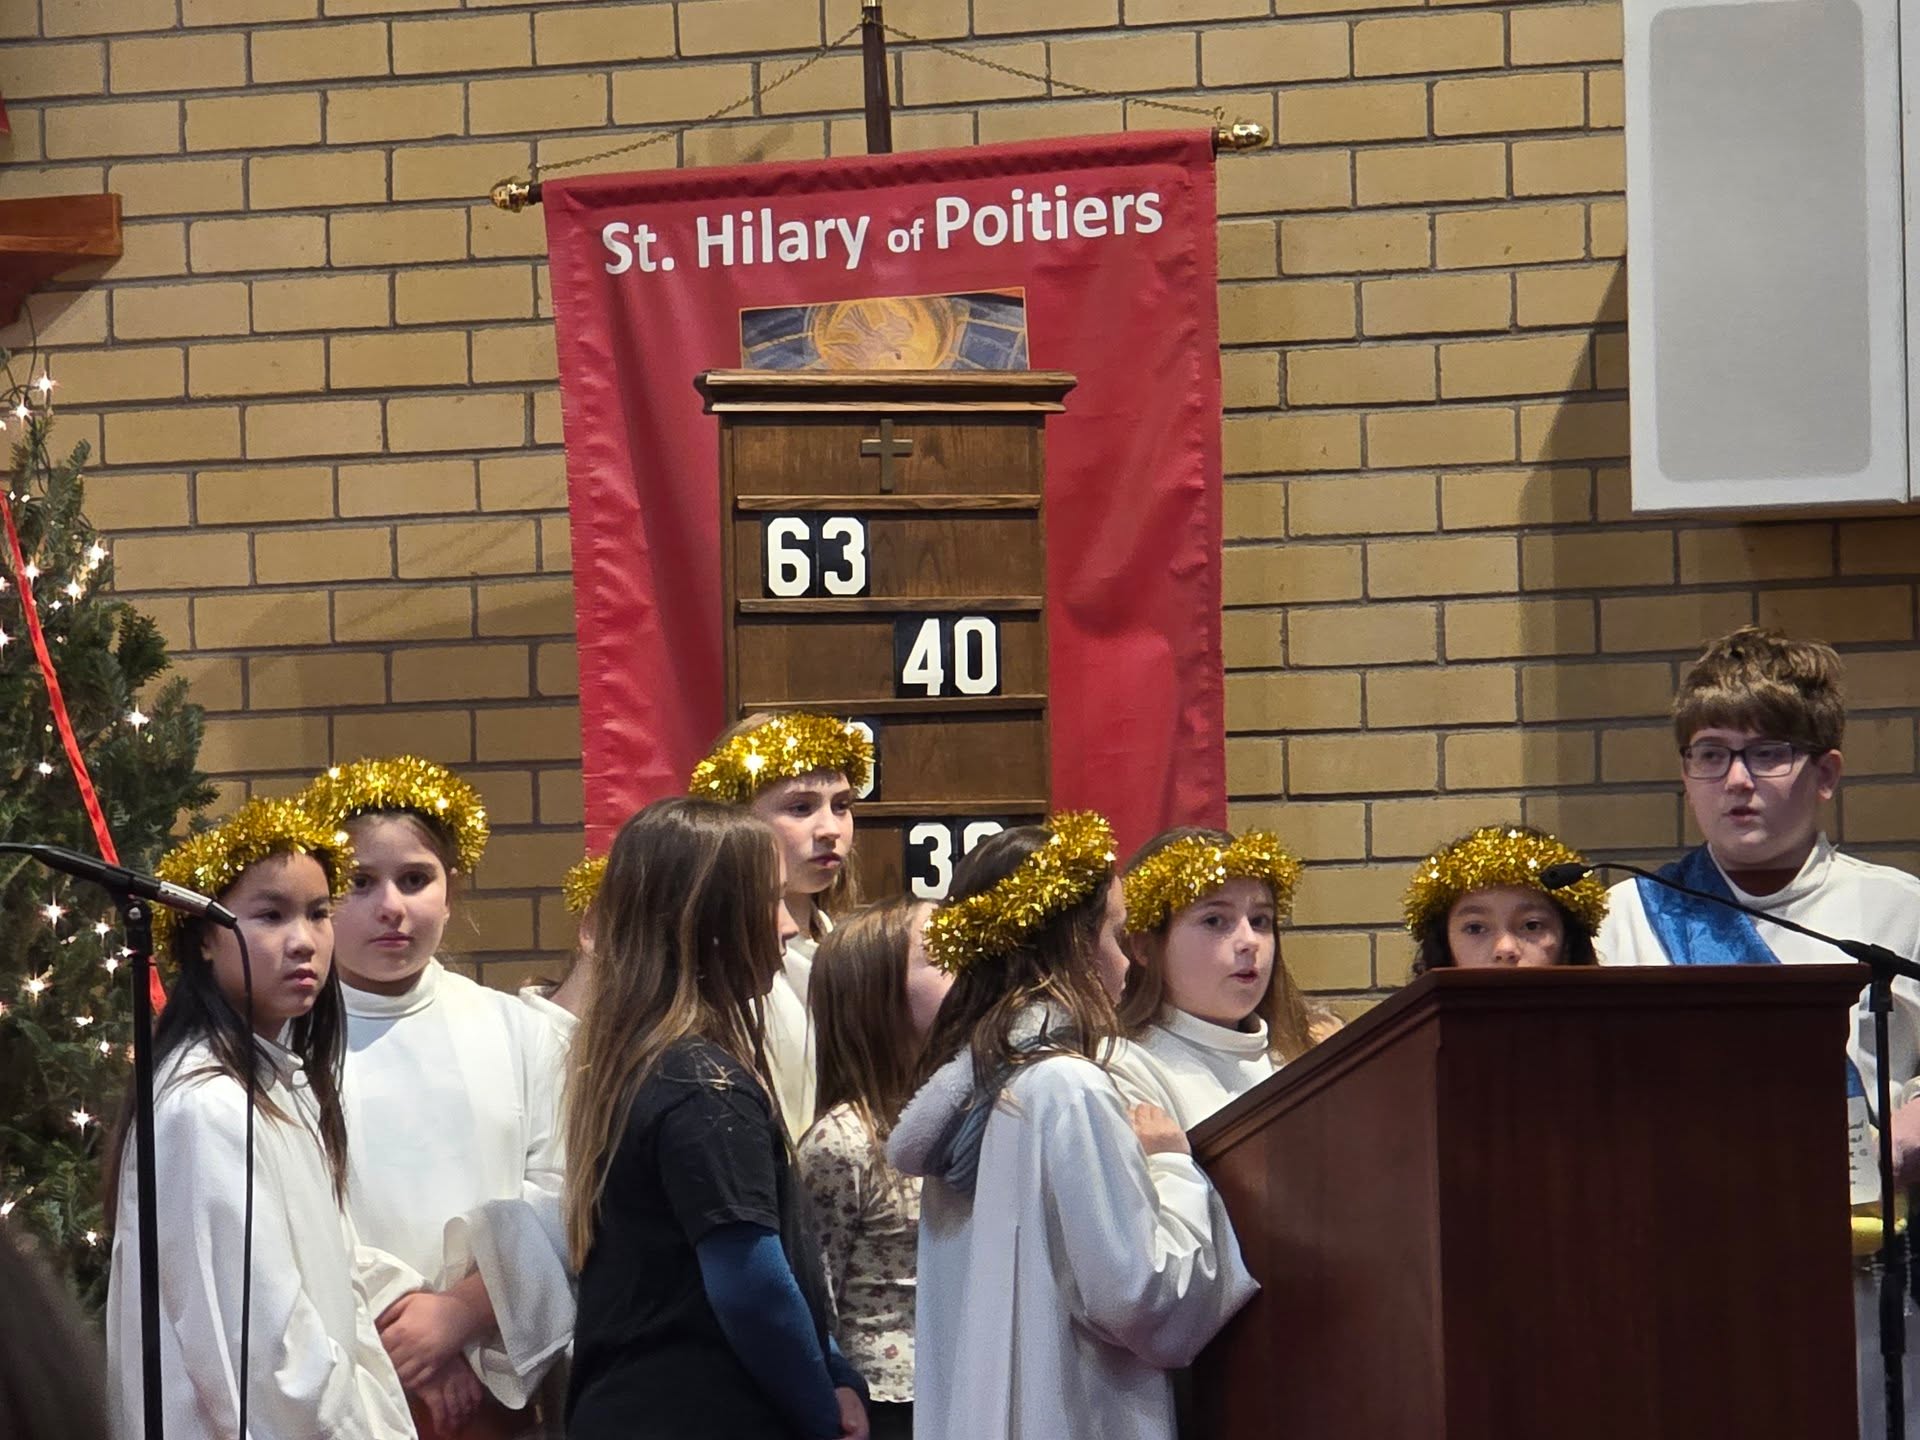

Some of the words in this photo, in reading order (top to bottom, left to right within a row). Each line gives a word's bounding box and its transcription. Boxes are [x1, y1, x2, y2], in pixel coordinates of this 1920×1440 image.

[603, 221, 675, 275] St.
[696, 207, 871, 270] Hilary
[887, 218, 925, 254] of
[935, 184, 1163, 250] Poitiers
[767, 516, 866, 597] 63
[902, 616, 998, 697] 40
[909, 821, 1005, 900] 3
